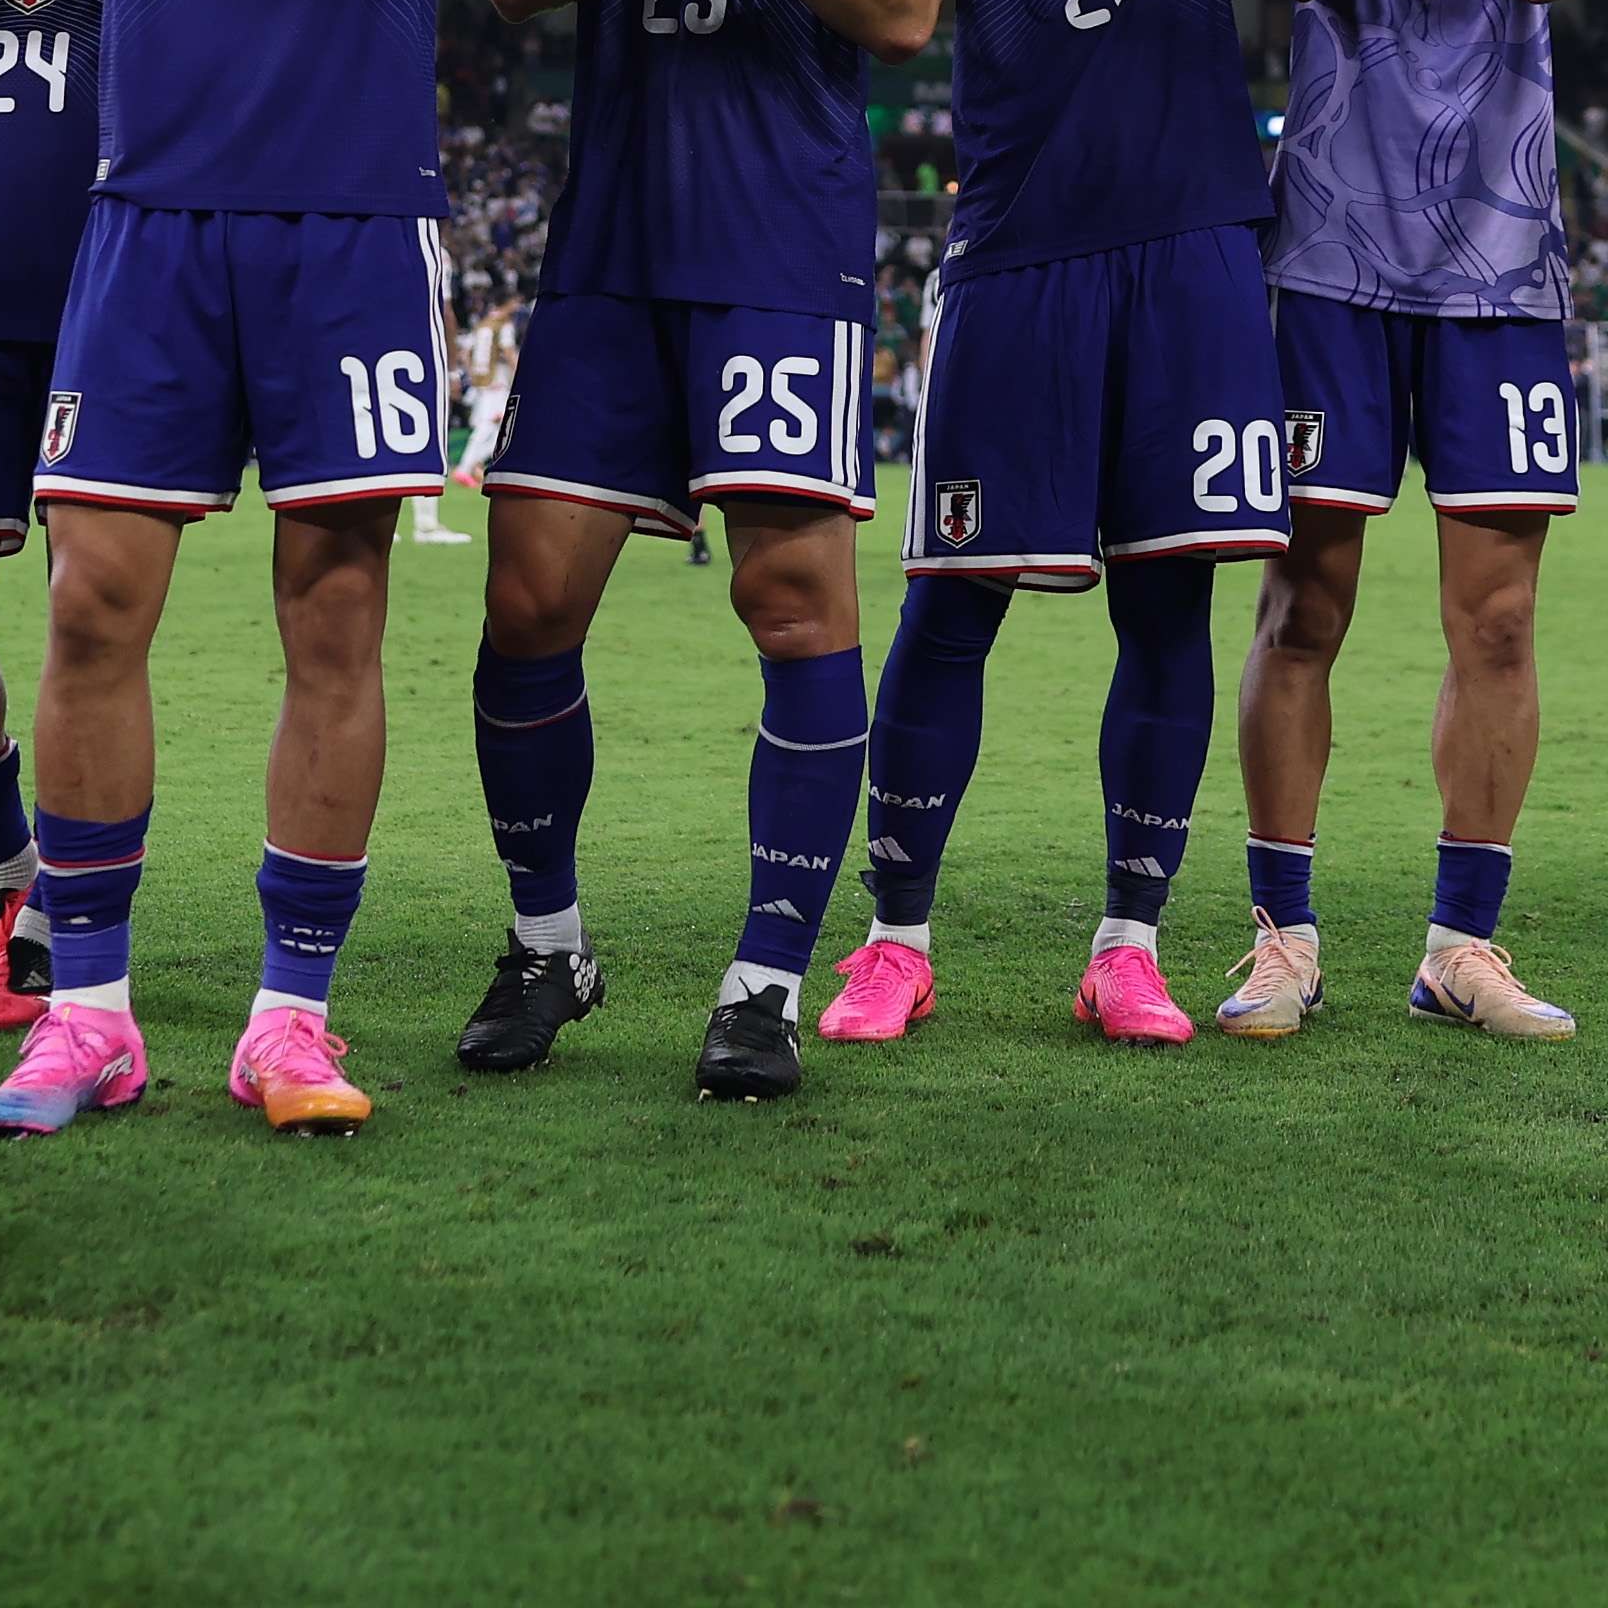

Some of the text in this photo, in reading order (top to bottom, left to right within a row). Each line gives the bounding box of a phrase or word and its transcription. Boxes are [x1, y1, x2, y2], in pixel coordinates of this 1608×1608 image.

[340, 349, 430, 460] 16
[718, 355, 820, 455] 25
[1499, 381, 1569, 475] 13
[1193, 419, 1283, 512] 20
[493, 814, 553, 833] PAN
[869, 786, 946, 809] APAN
